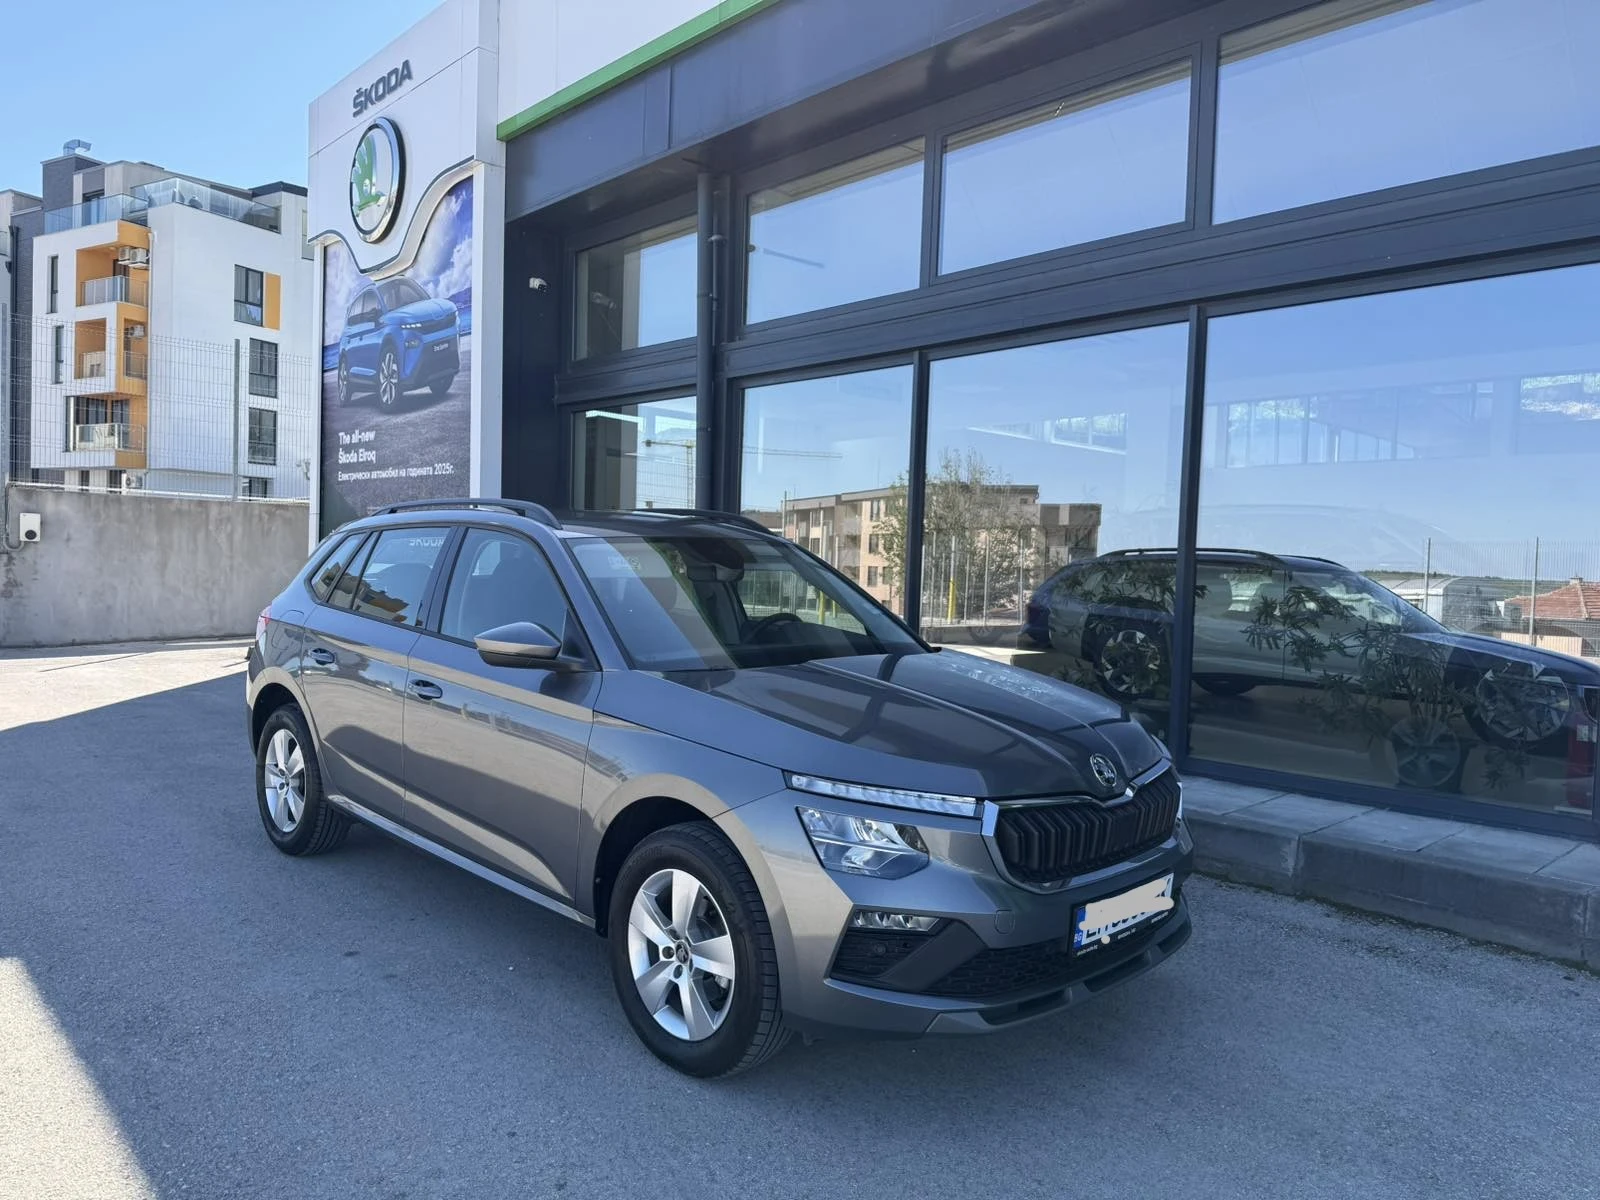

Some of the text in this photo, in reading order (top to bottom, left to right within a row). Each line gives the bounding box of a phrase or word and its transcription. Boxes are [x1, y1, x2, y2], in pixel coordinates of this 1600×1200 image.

[352, 59, 413, 118] ŠKODA
[338, 429, 376, 445] The all-new
[338, 448, 376, 464] Škoda Elroq
[1073, 932, 1082, 942] BG
